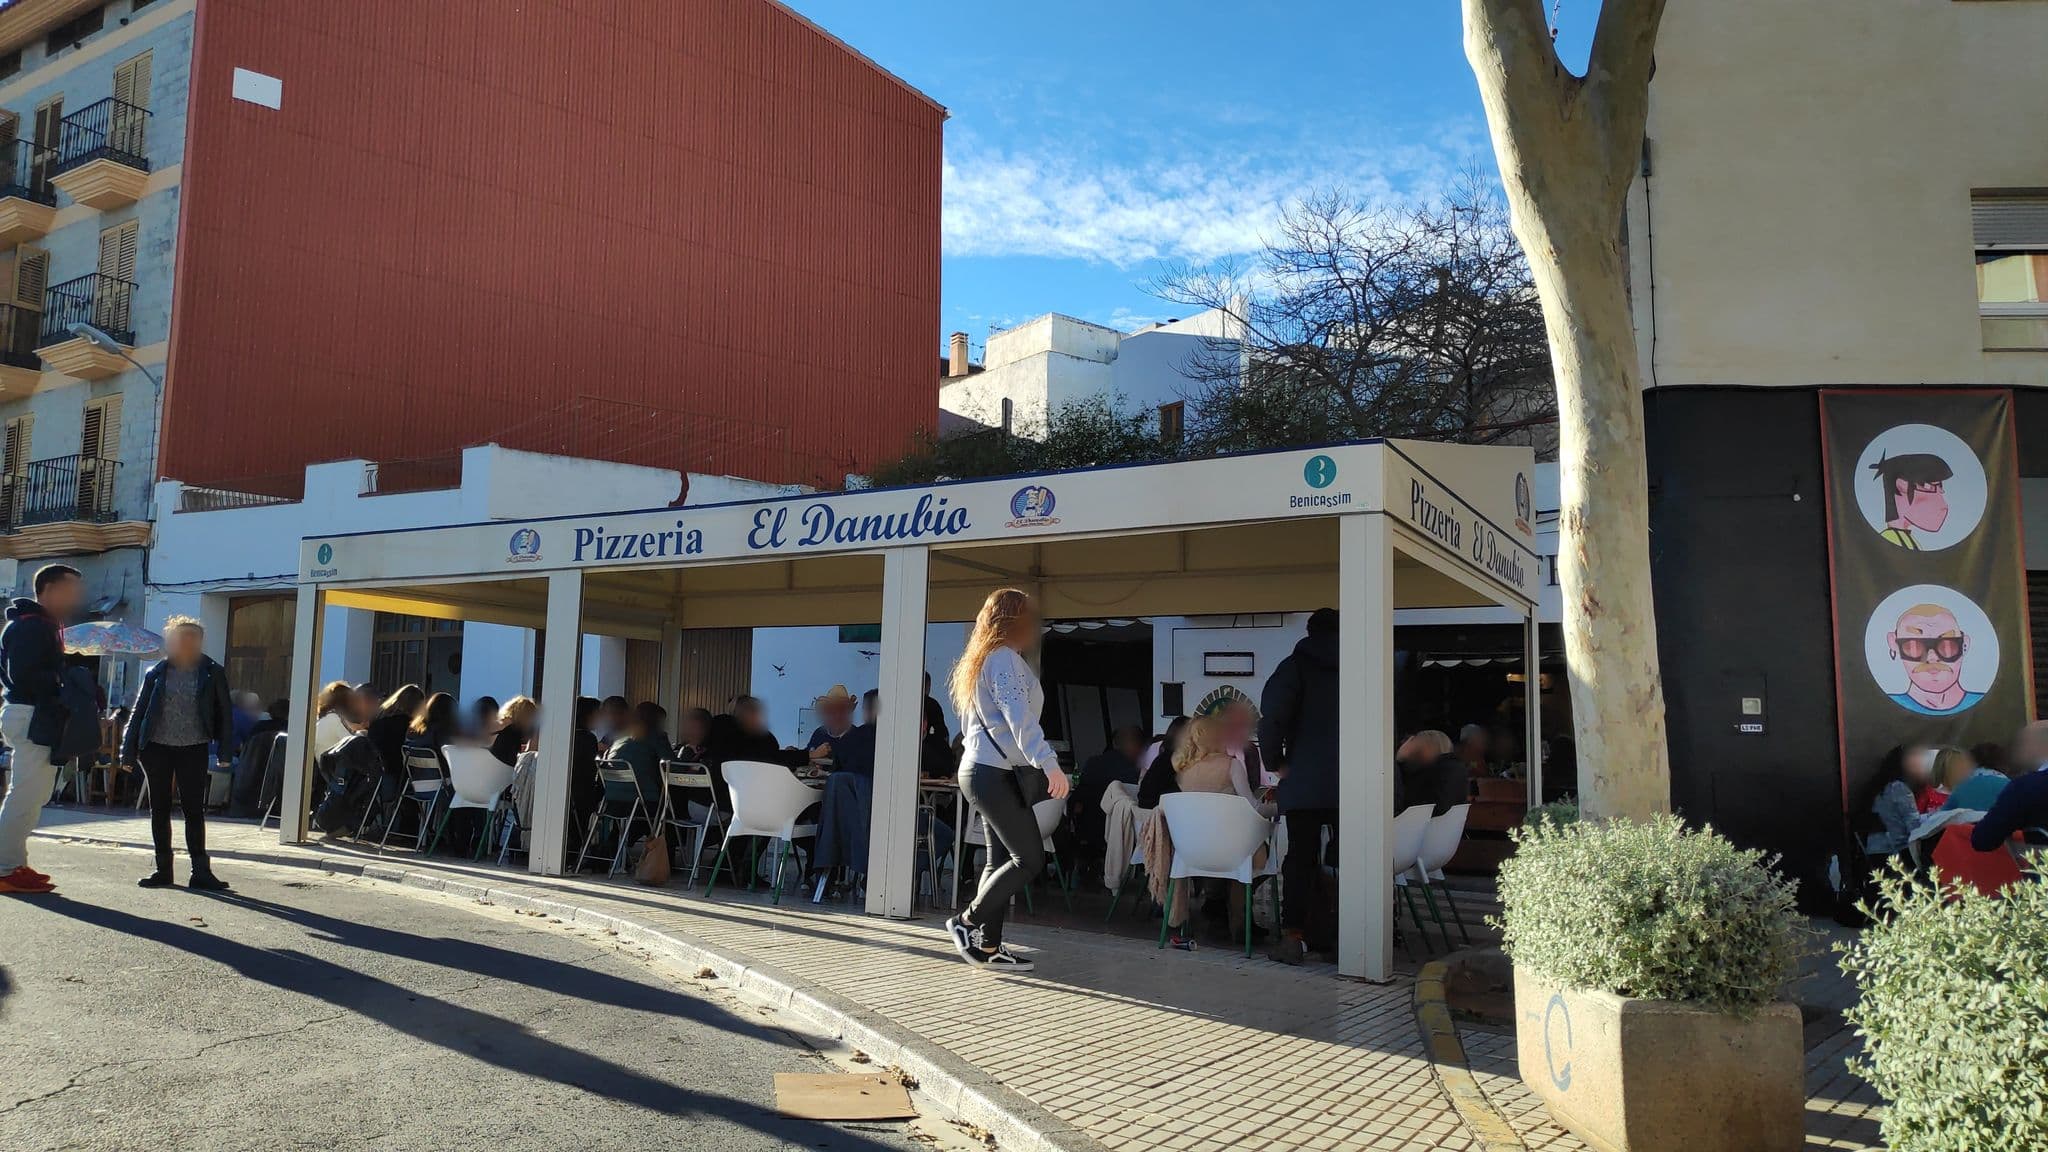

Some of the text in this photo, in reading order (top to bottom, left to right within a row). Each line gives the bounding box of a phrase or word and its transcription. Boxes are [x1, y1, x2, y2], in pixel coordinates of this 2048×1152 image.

[572, 493, 972, 562] Pizzeria El Danubio
[1411, 477, 1461, 550] Pizzeria
[1473, 520, 1484, 564] El
[1486, 530, 1525, 589] Danubio
